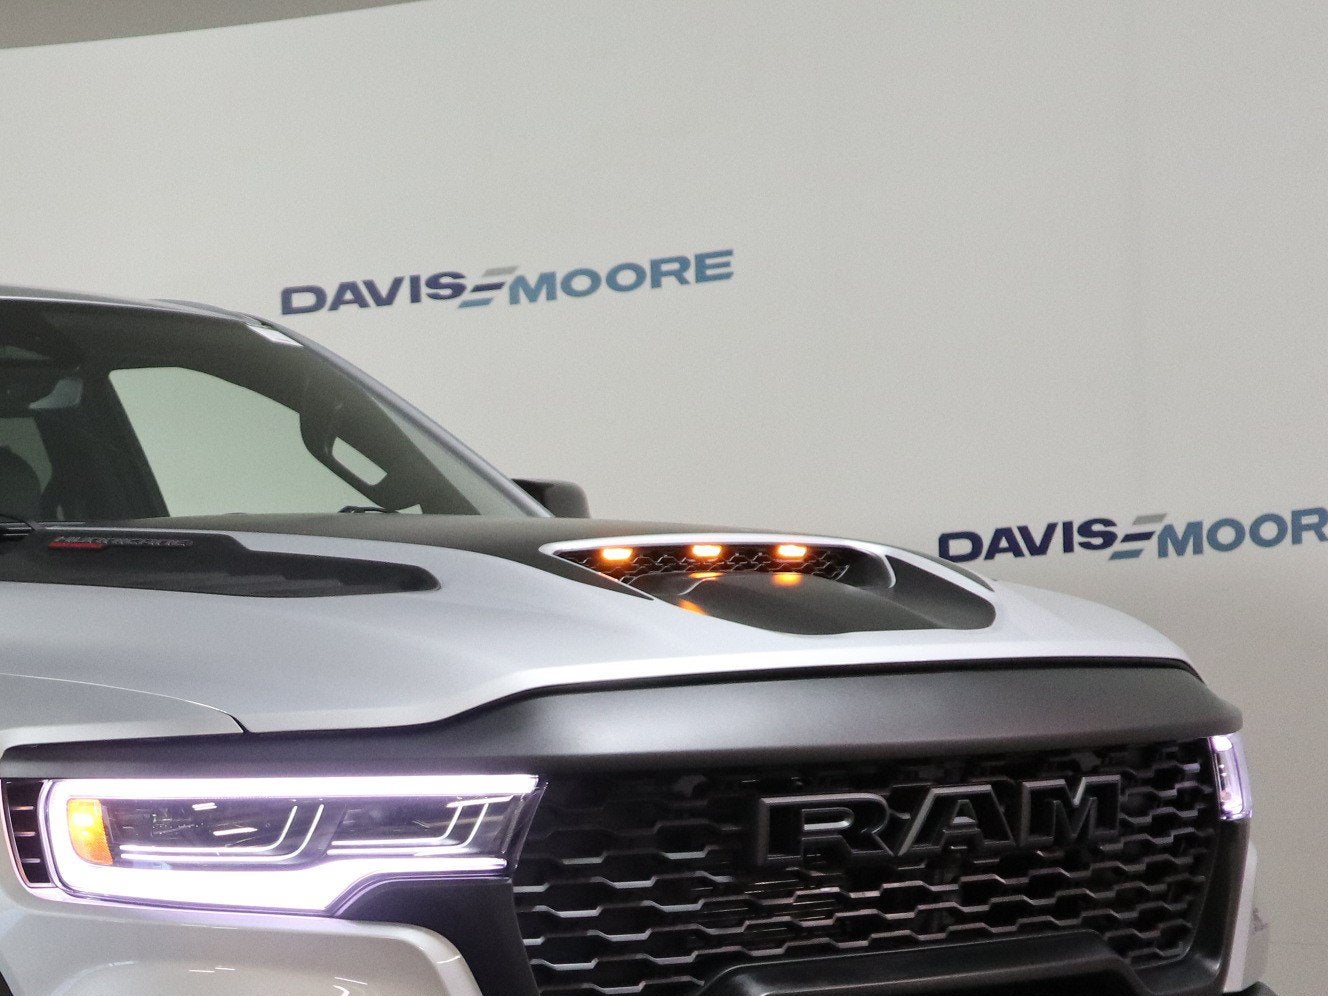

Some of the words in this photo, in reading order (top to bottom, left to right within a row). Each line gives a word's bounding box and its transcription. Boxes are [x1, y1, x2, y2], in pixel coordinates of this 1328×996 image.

[280, 271, 468, 316] DAVIS
[508, 249, 734, 306] MOORE
[937, 517, 1119, 562] DAVIS
[1157, 506, 1328, 559] MOOR
[760, 774, 1121, 864] RAM
